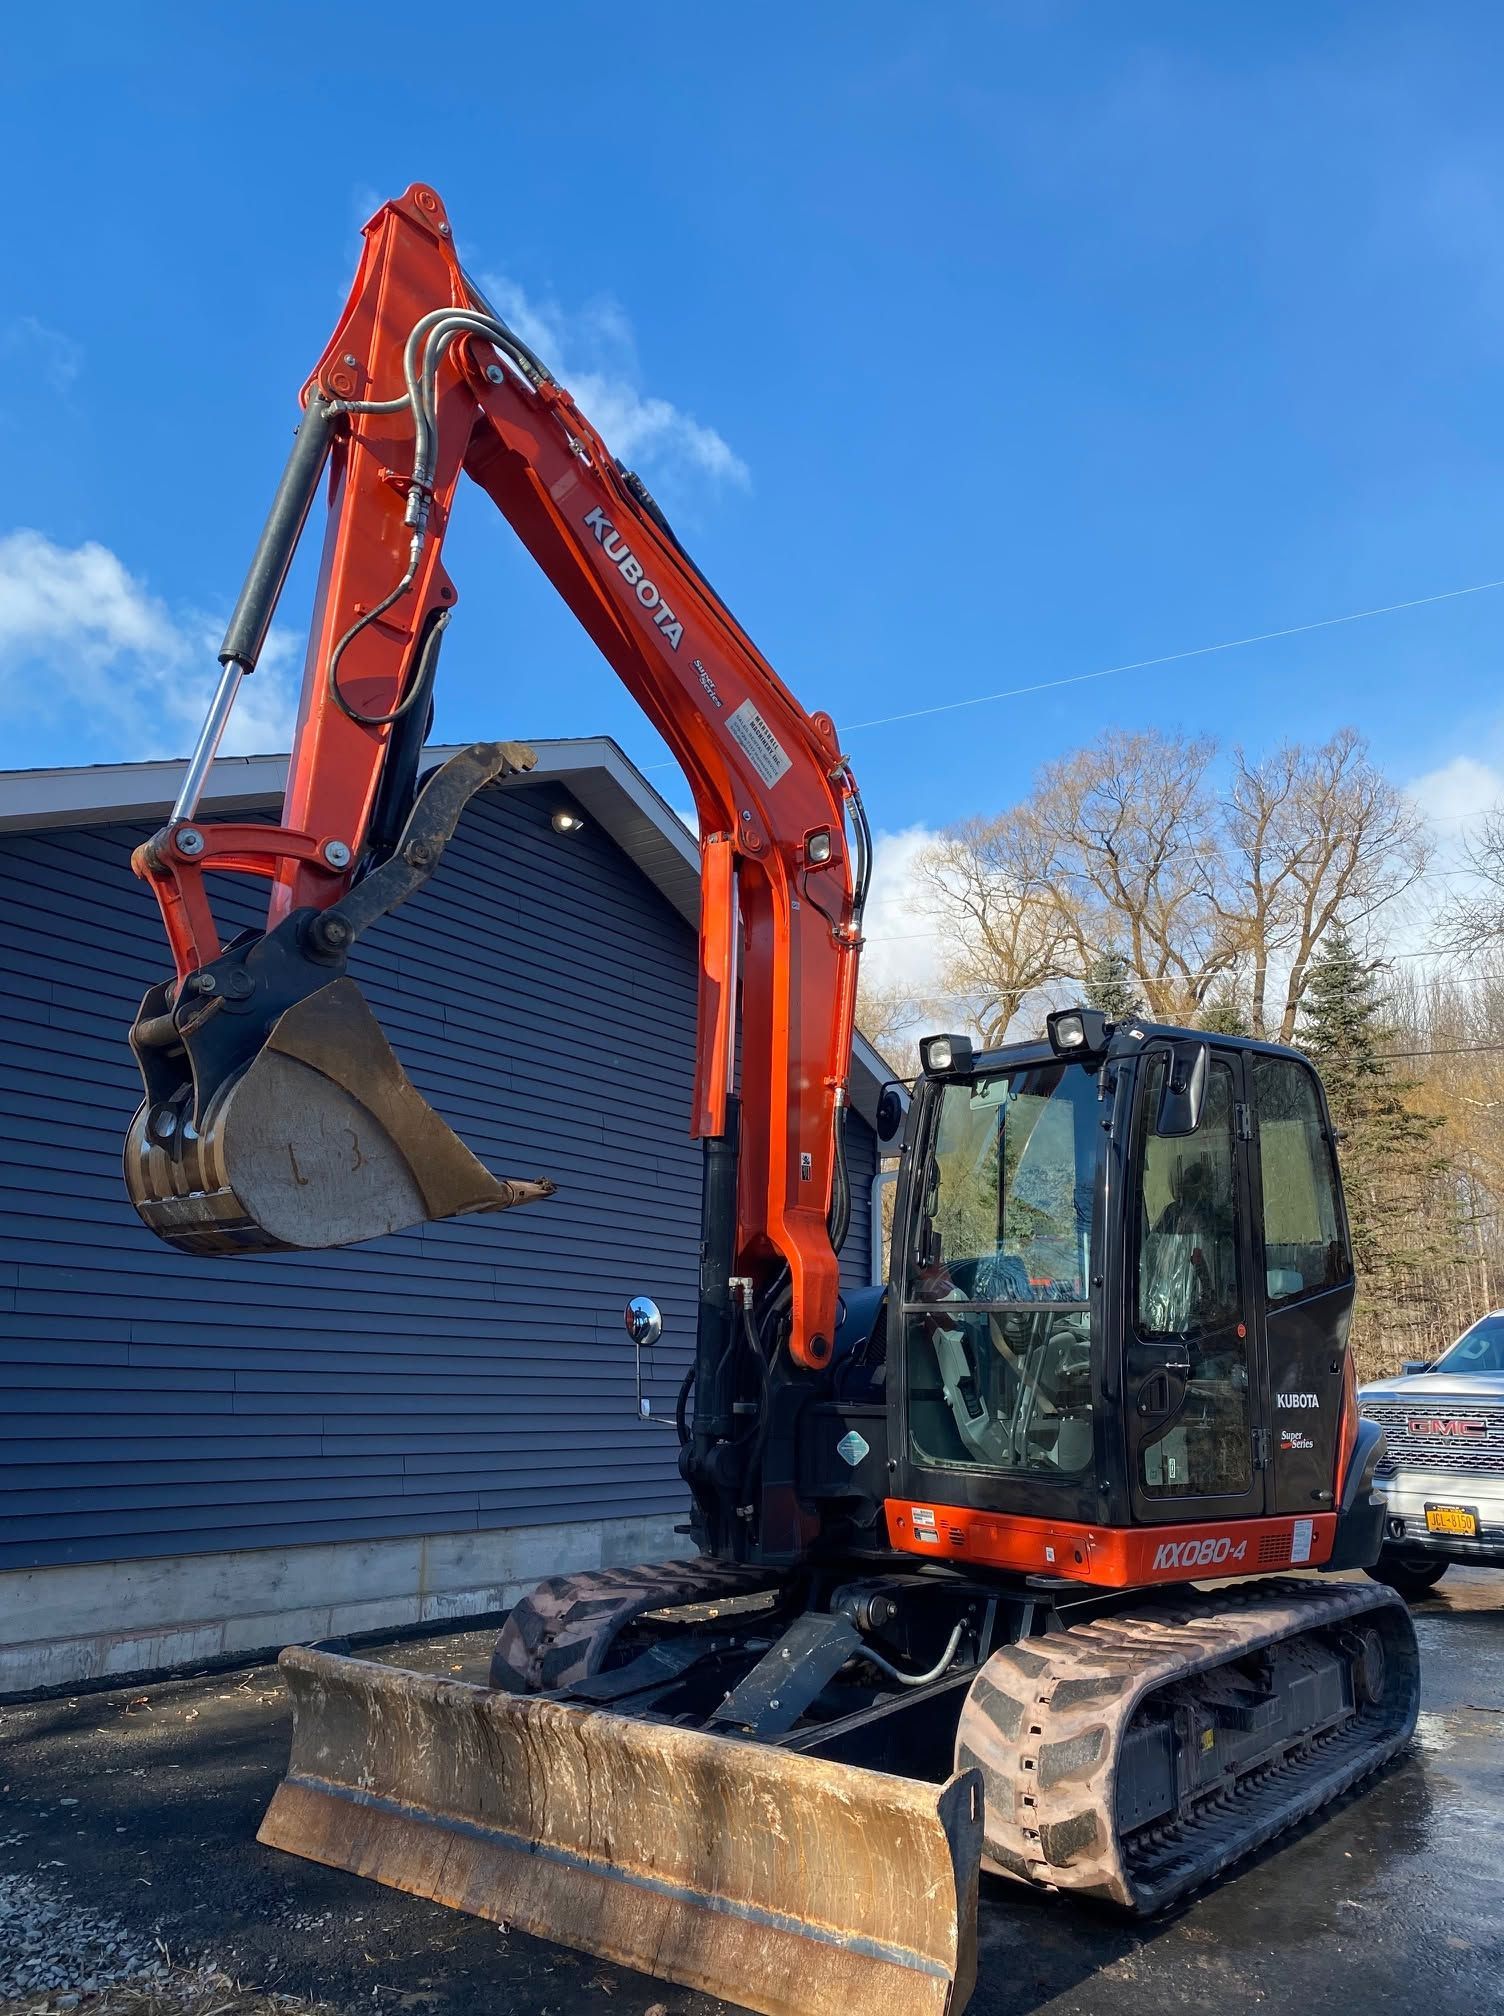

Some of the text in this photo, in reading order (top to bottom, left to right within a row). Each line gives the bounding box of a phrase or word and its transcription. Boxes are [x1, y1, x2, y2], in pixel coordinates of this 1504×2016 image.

[584, 506, 685, 651] KUBOTA
[754, 715, 779, 750] MARSHALL
[1277, 1393, 1320, 1408] KUBOTA
[1281, 1430, 1303, 1442] Super
[1409, 1420, 1486, 1437] GMC
[1291, 1438, 1314, 1449] Series
[1152, 1537, 1248, 1571] KX080-4
